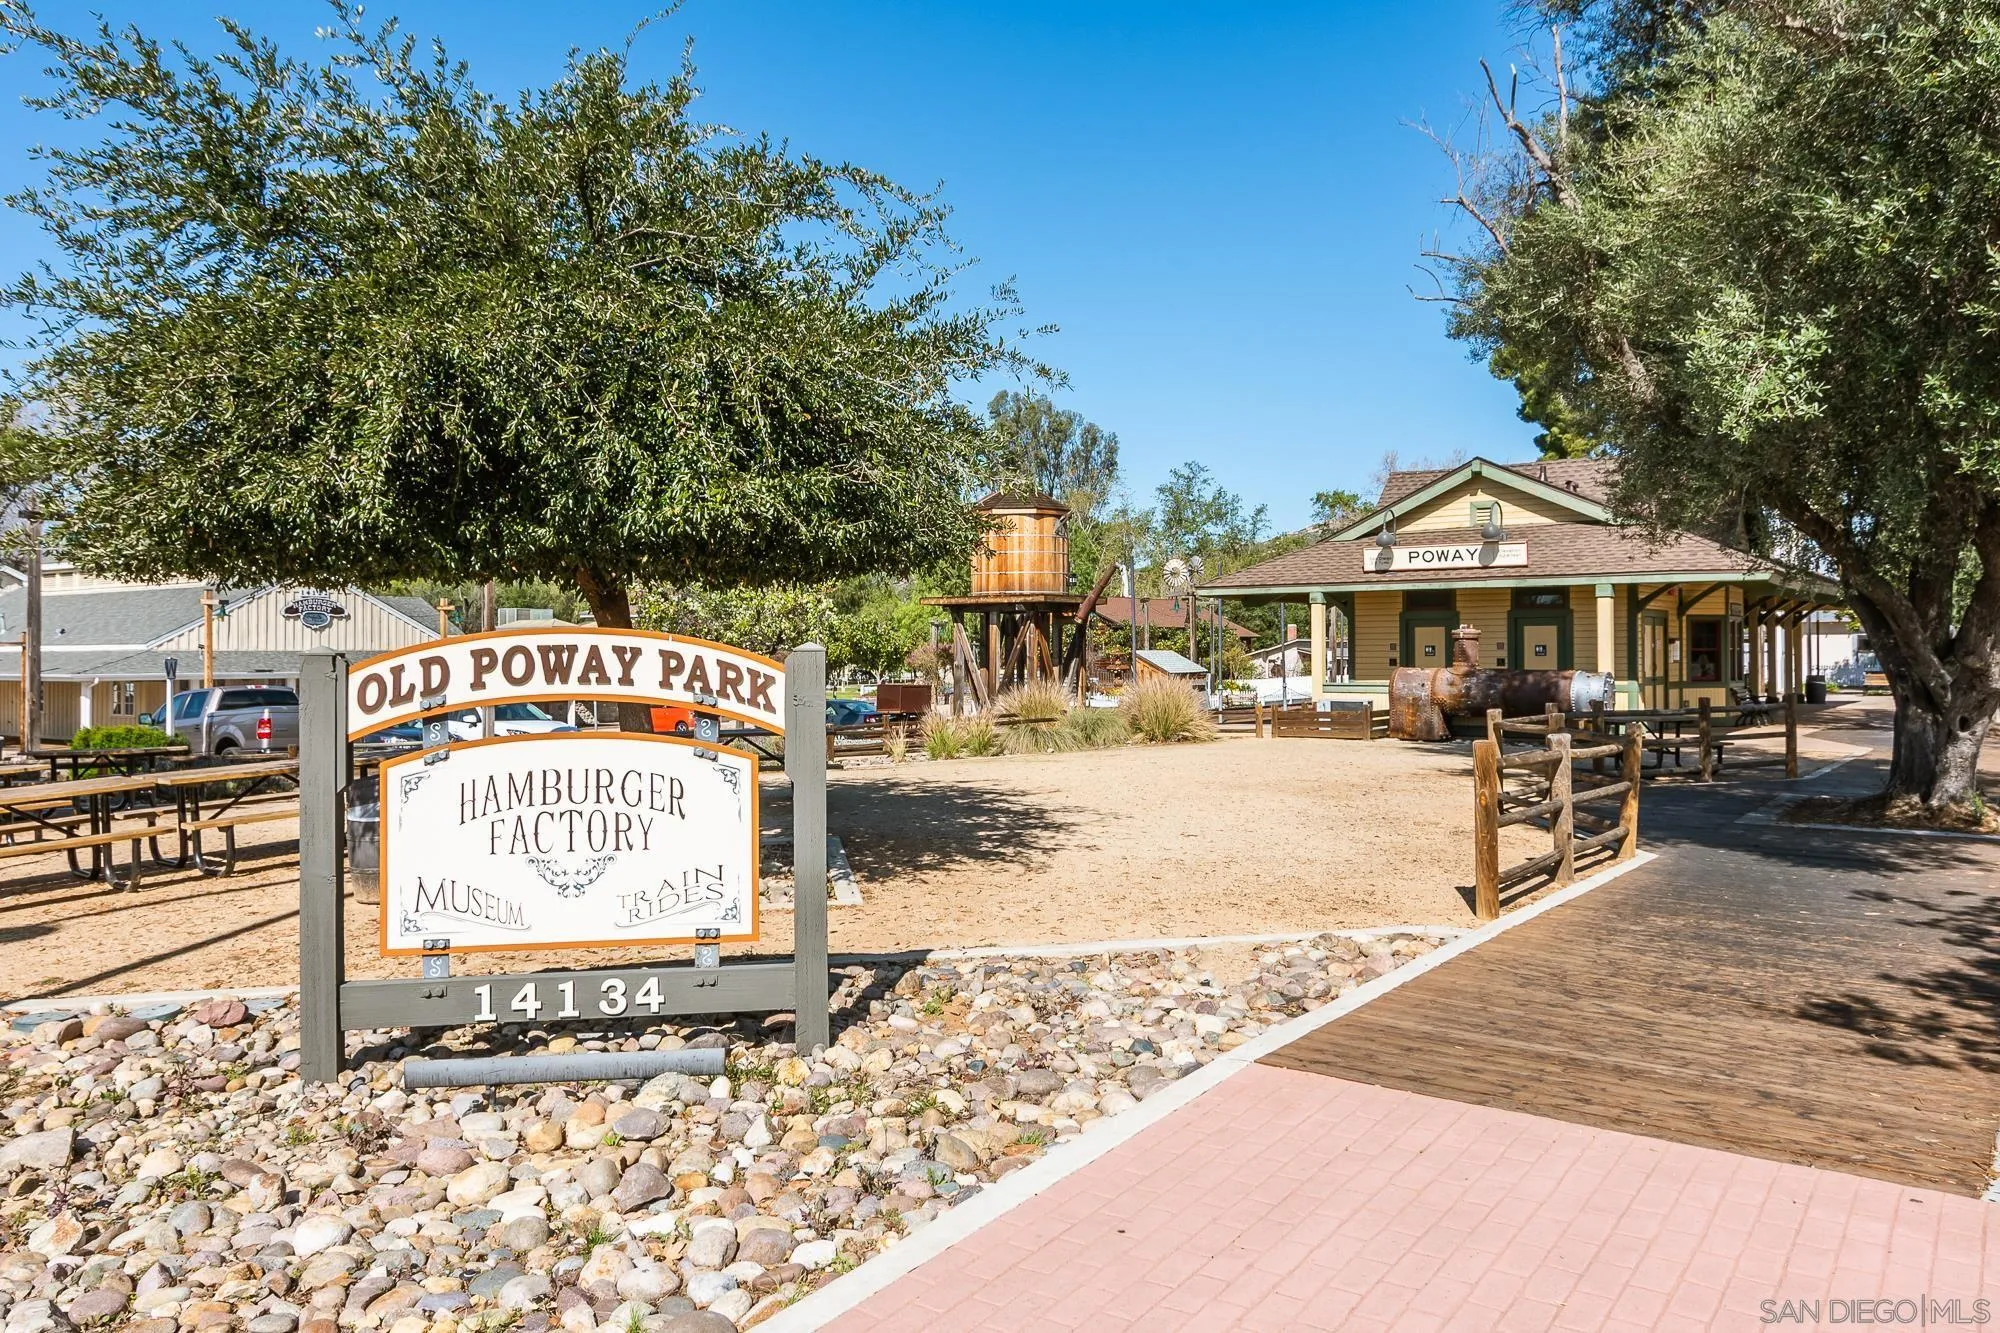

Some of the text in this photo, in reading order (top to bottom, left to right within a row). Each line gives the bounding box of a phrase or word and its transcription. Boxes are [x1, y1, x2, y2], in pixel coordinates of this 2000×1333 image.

[1408, 549, 1478, 564] POWAY
[357, 644, 777, 715] OLD POWAY PARK
[459, 768, 686, 826] HAMBURGER
[489, 809, 654, 856] FACTORY
[414, 876, 525, 926] MUSEUM
[616, 864, 723, 909] TRAIN
[629, 883, 724, 923] RIDES
[473, 976, 666, 1022] 14134
